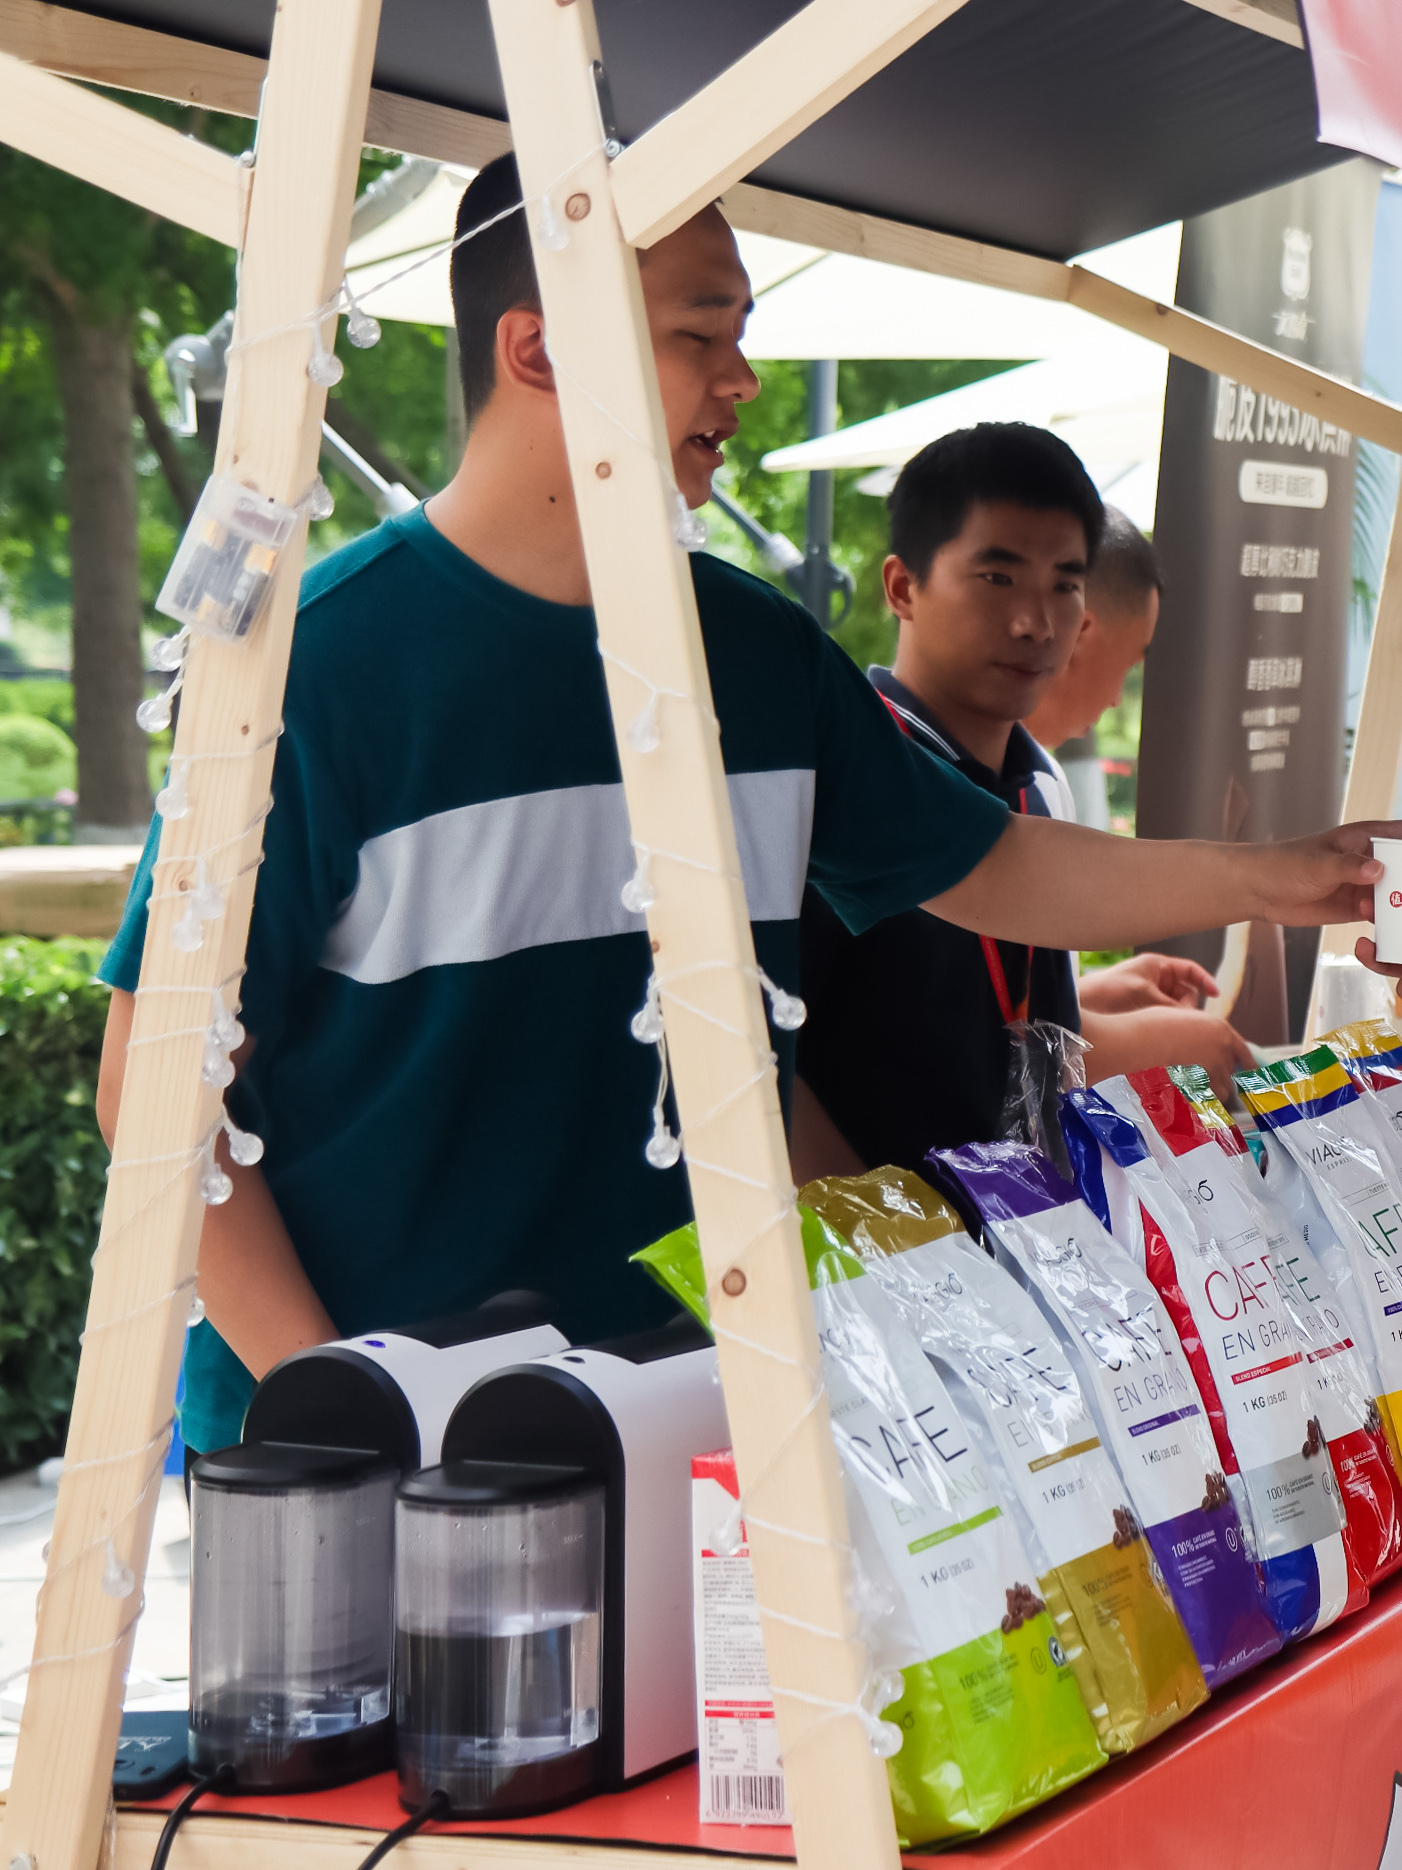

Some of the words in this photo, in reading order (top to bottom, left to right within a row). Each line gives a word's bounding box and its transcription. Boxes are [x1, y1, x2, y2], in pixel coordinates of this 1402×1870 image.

[1222, 1328, 1256, 1361] EN
[1391, 1331, 1396, 1342] 1
[1113, 1381, 1142, 1412] EN
[1242, 1401, 1249, 1413] 1
[1251, 1396, 1266, 1411] KG
[1141, 1454, 1149, 1466] 1
[1148, 1449, 1161, 1464] KG
[1042, 1491, 1049, 1504] 1
[1050, 1484, 1066, 1501] KG
[1266, 1483, 1291, 1501] 100%
[1171, 1539, 1195, 1558] 100%
[921, 1575, 929, 1588] 1
